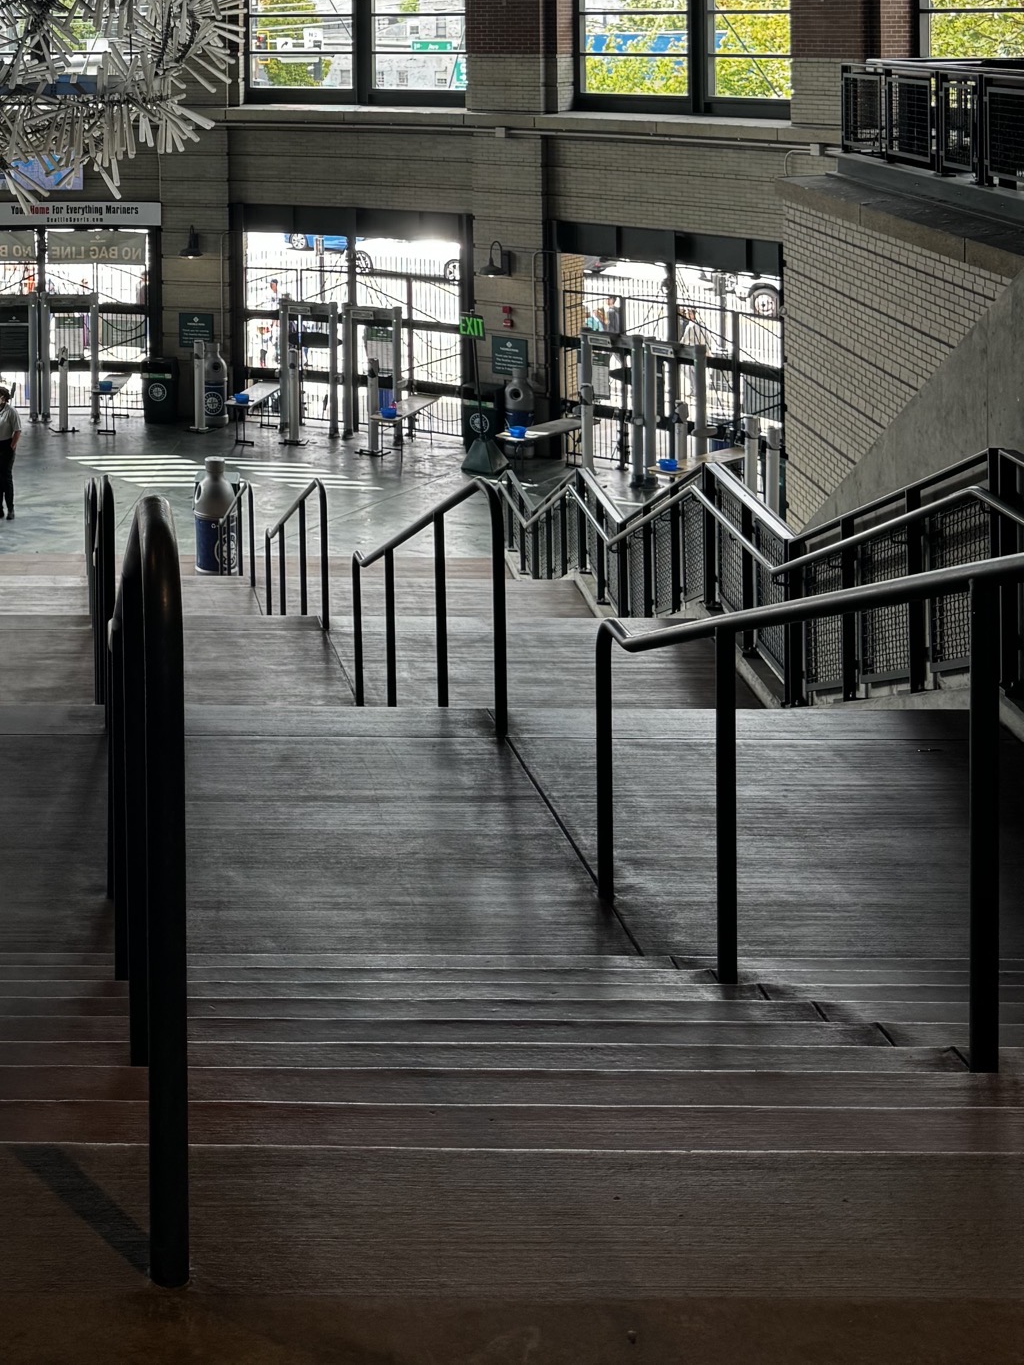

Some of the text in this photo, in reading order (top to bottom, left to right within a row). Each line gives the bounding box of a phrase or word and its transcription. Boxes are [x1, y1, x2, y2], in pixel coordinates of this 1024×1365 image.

[29, 205, 50, 215] Home
[52, 205, 64, 215] For
[66, 204, 103, 216] Everything
[105, 205, 139, 215] Mariners
[459, 316, 484, 337] EXIT
